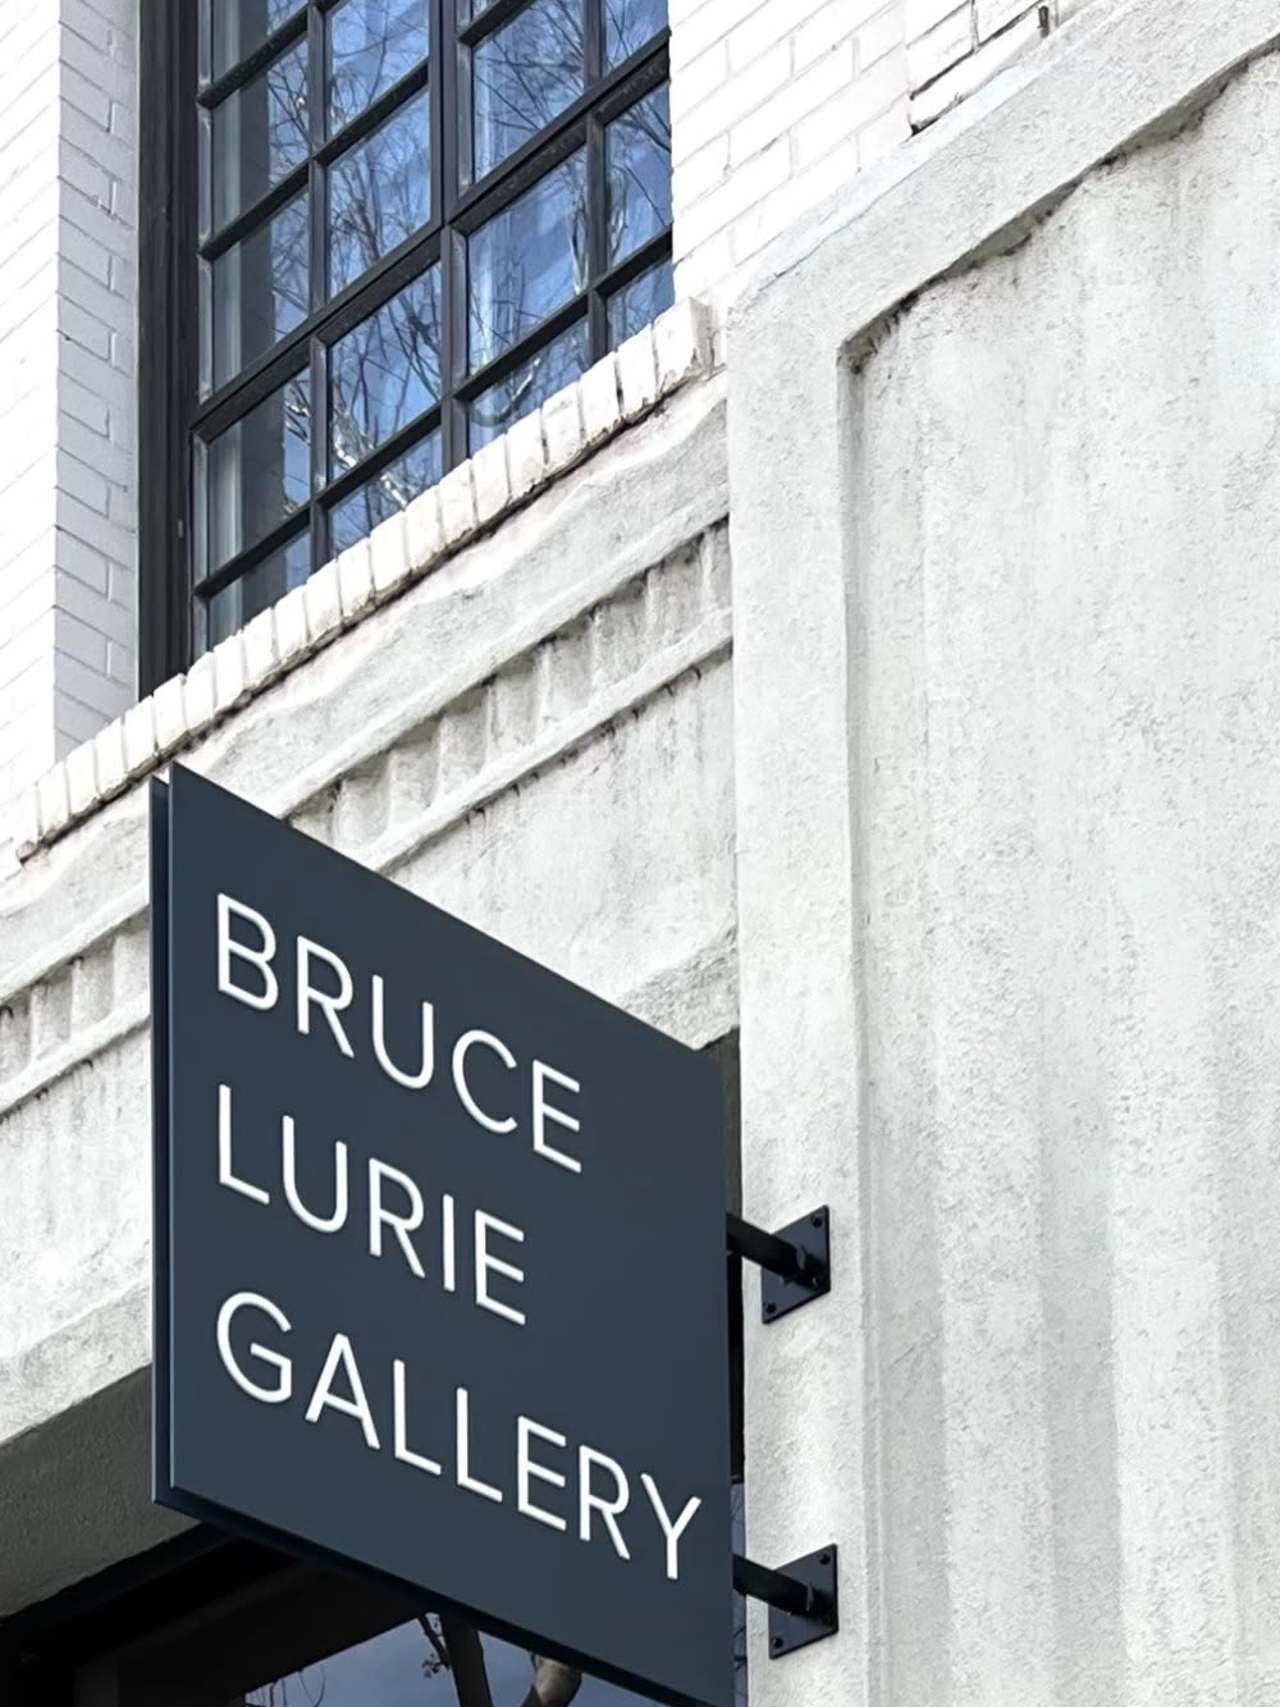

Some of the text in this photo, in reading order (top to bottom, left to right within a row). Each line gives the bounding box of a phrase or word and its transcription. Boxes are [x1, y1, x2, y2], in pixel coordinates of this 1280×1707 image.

[216, 891, 583, 1175] BRUCE
[217, 1083, 527, 1327] LURIE
[215, 1290, 703, 1581] GALLERY
